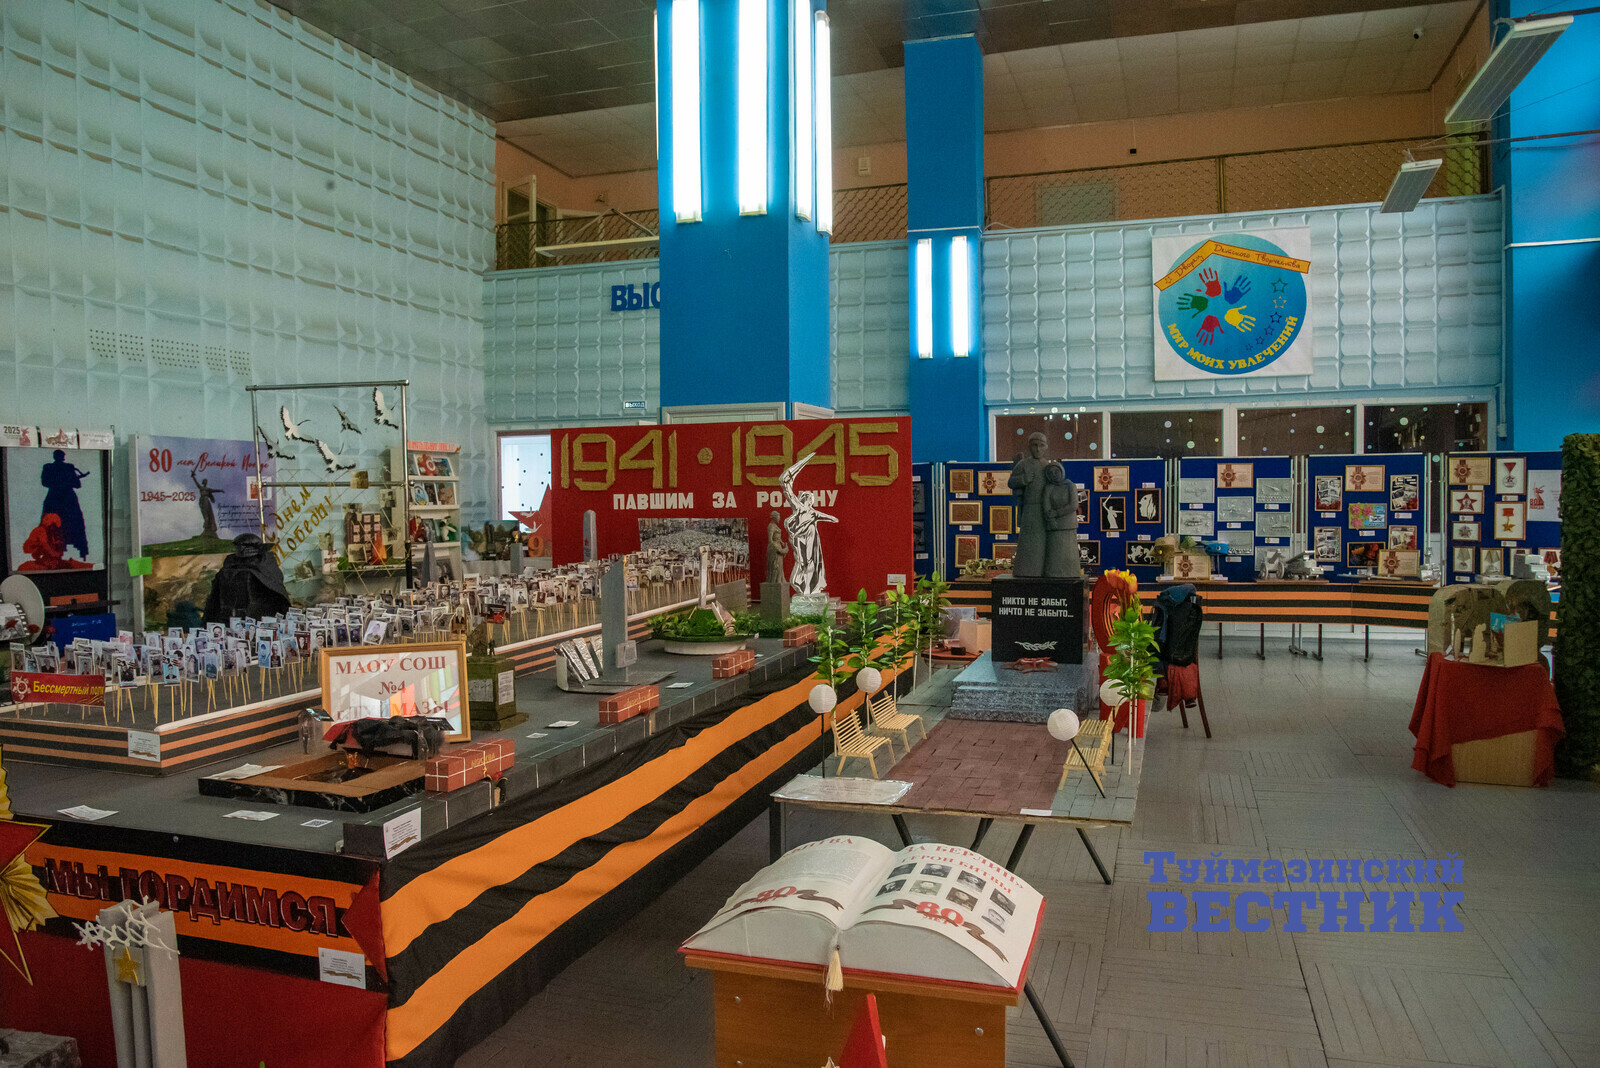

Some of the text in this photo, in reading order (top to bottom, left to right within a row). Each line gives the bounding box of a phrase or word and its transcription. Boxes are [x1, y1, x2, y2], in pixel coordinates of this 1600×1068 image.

[1167, 315, 1298, 370] МИР МОИХ УВЛЕЧЕНИЙ
[3, 426, 20, 434] 2025
[149, 448, 172, 472] 80
[190, 452, 238, 472] Великой
[560, 422, 899, 491] 1941 1945
[613, 489, 839, 510] ПАВШИМ ЗА РОНУ
[1002, 597, 1068, 607] НИКТО НЕ ЗАБЫТ,
[998, 608, 1074, 618] НИЧТО НЕ ЗАБЫТО...
[335, 655, 447, 675] МАОУ СОШ
[33, 680, 105, 697] Бессмертный полк
[378, 680, 406, 695] №4
[959, 860, 1012, 895] БИТВЫ
[44, 858, 338, 938] МЫ ГОРДИМСЯ
[916, 901, 964, 925] 80
